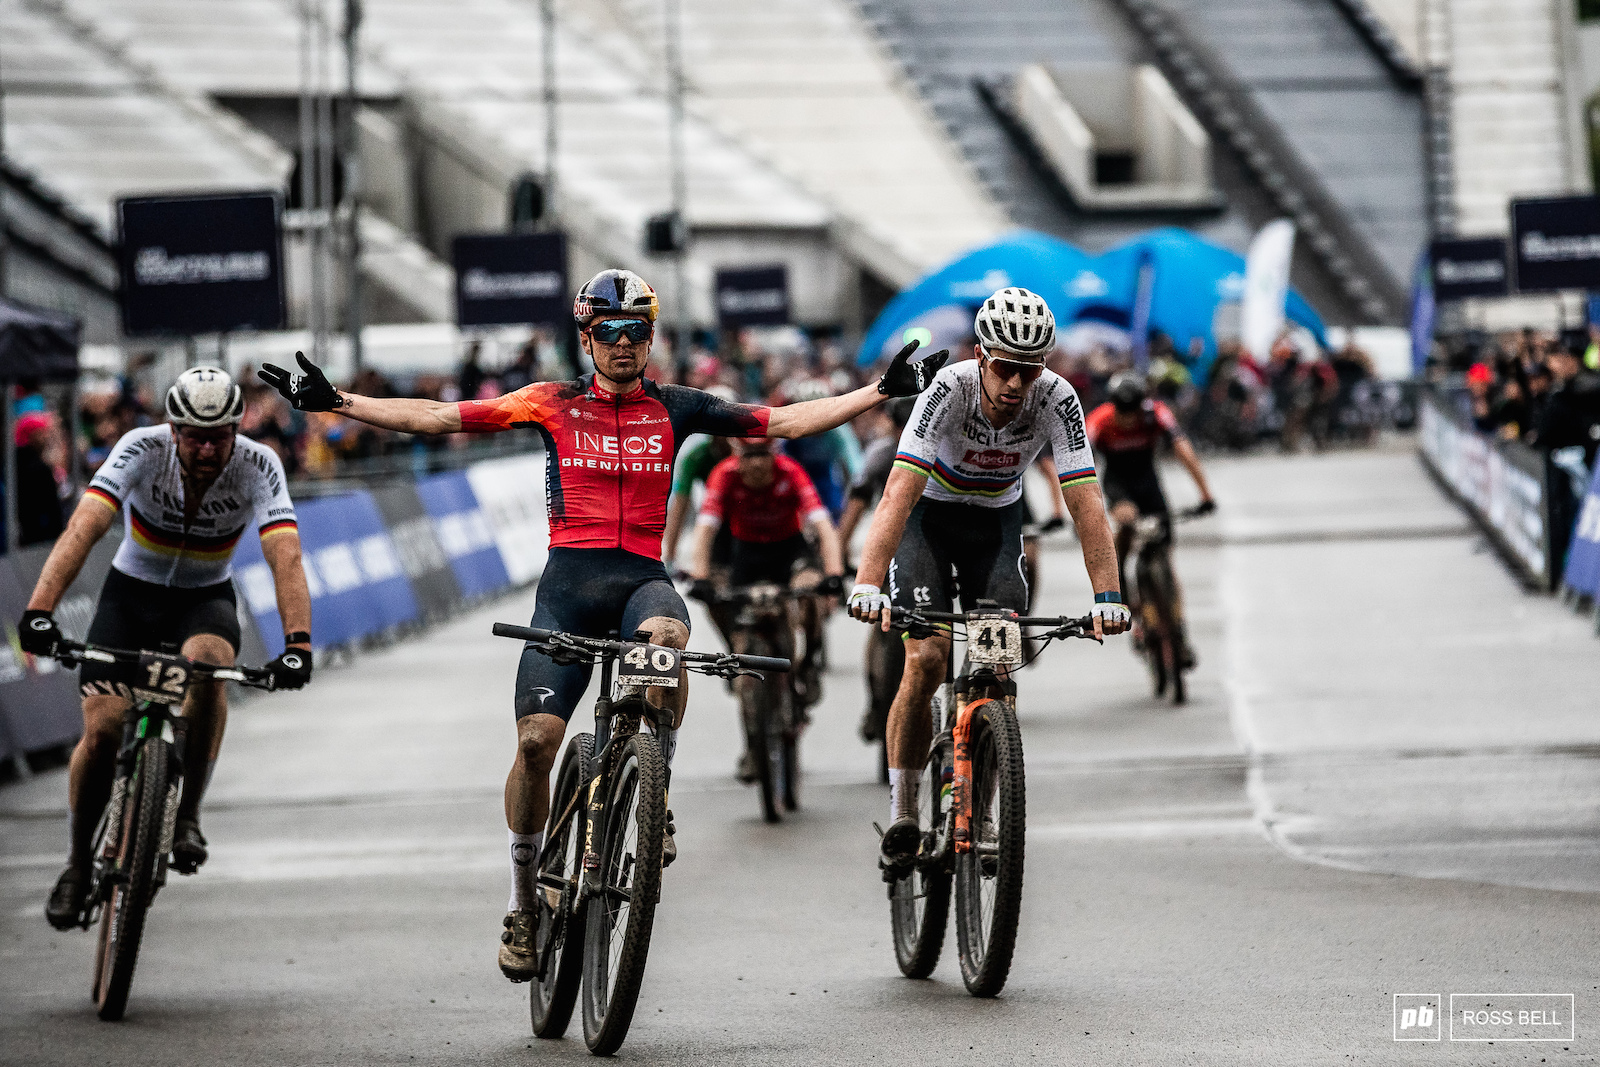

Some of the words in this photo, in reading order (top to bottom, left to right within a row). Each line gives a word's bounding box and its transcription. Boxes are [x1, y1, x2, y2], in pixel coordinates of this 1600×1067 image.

[627, 416, 670, 425] PINARELLO
[913, 381, 951, 439] deceuninck
[1058, 394, 1086, 451] Alpecin
[112, 436, 164, 469] CANYON
[574, 430, 662, 454] INEOS
[562, 458, 670, 472] GRENADIER
[970, 453, 1015, 465] Alpecin
[243, 448, 282, 498] CANYON
[978, 627, 1007, 650] 41
[624, 646, 675, 672] 40
[146, 660, 187, 694] 12
